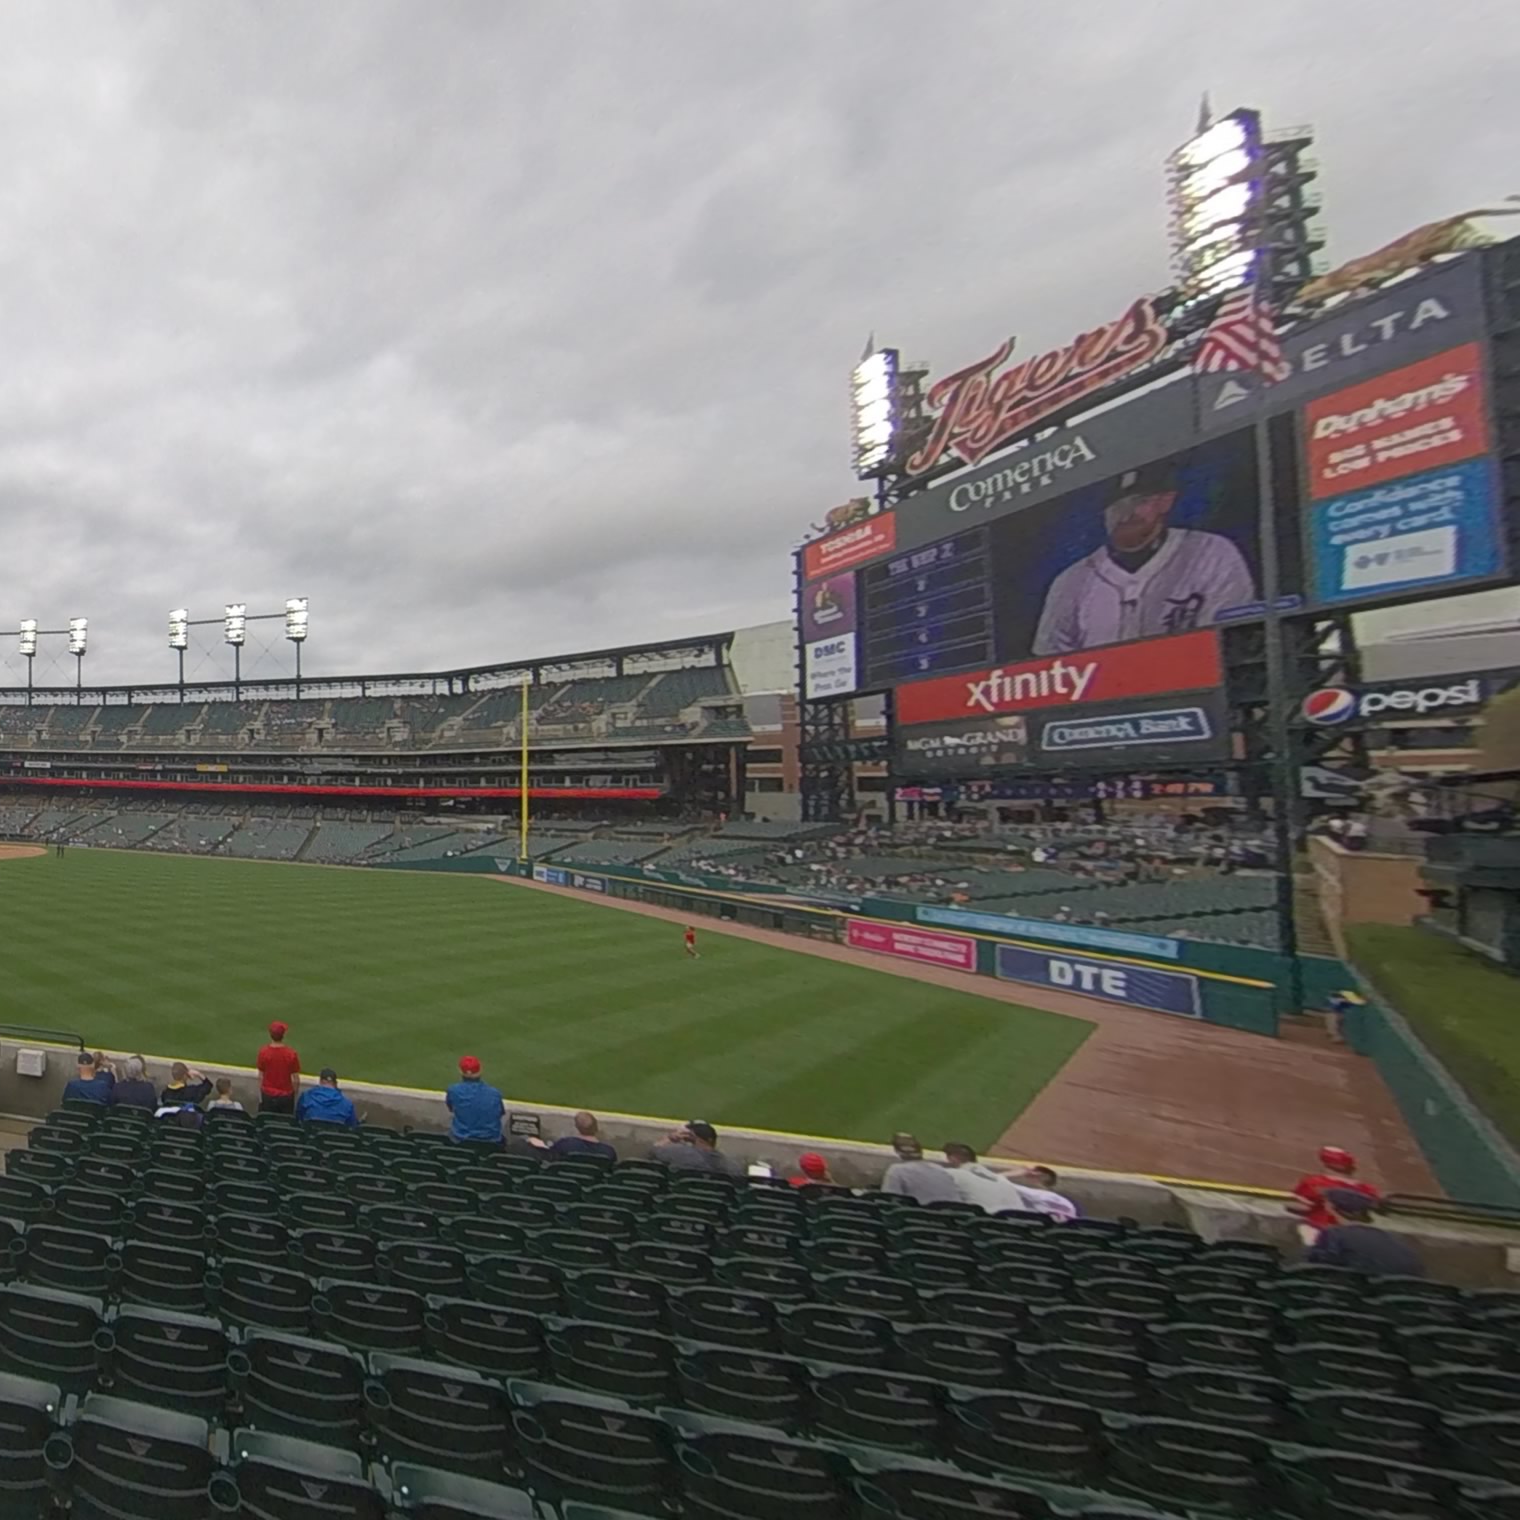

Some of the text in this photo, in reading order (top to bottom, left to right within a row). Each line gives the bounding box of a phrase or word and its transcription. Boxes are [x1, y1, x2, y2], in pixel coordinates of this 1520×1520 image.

[1277, 298, 1450, 382] ELTA
[905, 295, 1168, 475] Tigers
[984, 472, 1053, 508] PARK
[966, 660, 1098, 711] xfinity
[1360, 679, 1479, 716] pepsi
[906, 728, 1026, 750] MGM GRAND
[1139, 716, 1196, 735] Bank
[1048, 959, 1128, 997] DTE
